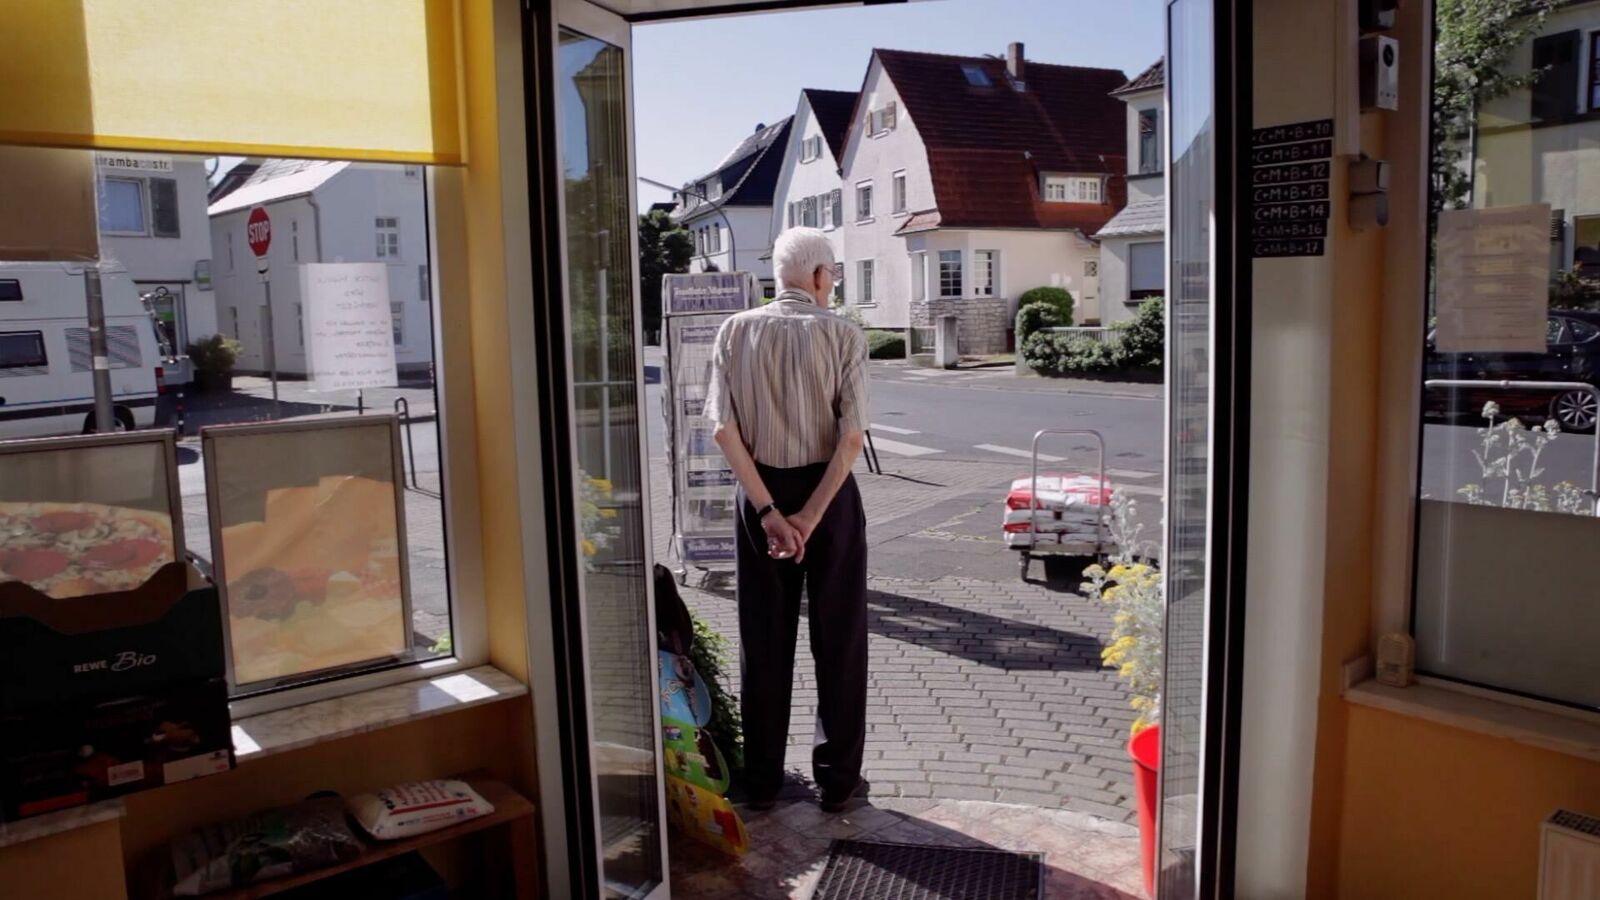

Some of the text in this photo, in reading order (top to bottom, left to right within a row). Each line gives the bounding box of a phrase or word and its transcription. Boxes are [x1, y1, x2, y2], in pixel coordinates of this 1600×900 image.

[249, 220, 269, 244] STOP
[74, 651, 157, 673] REWE Bio
